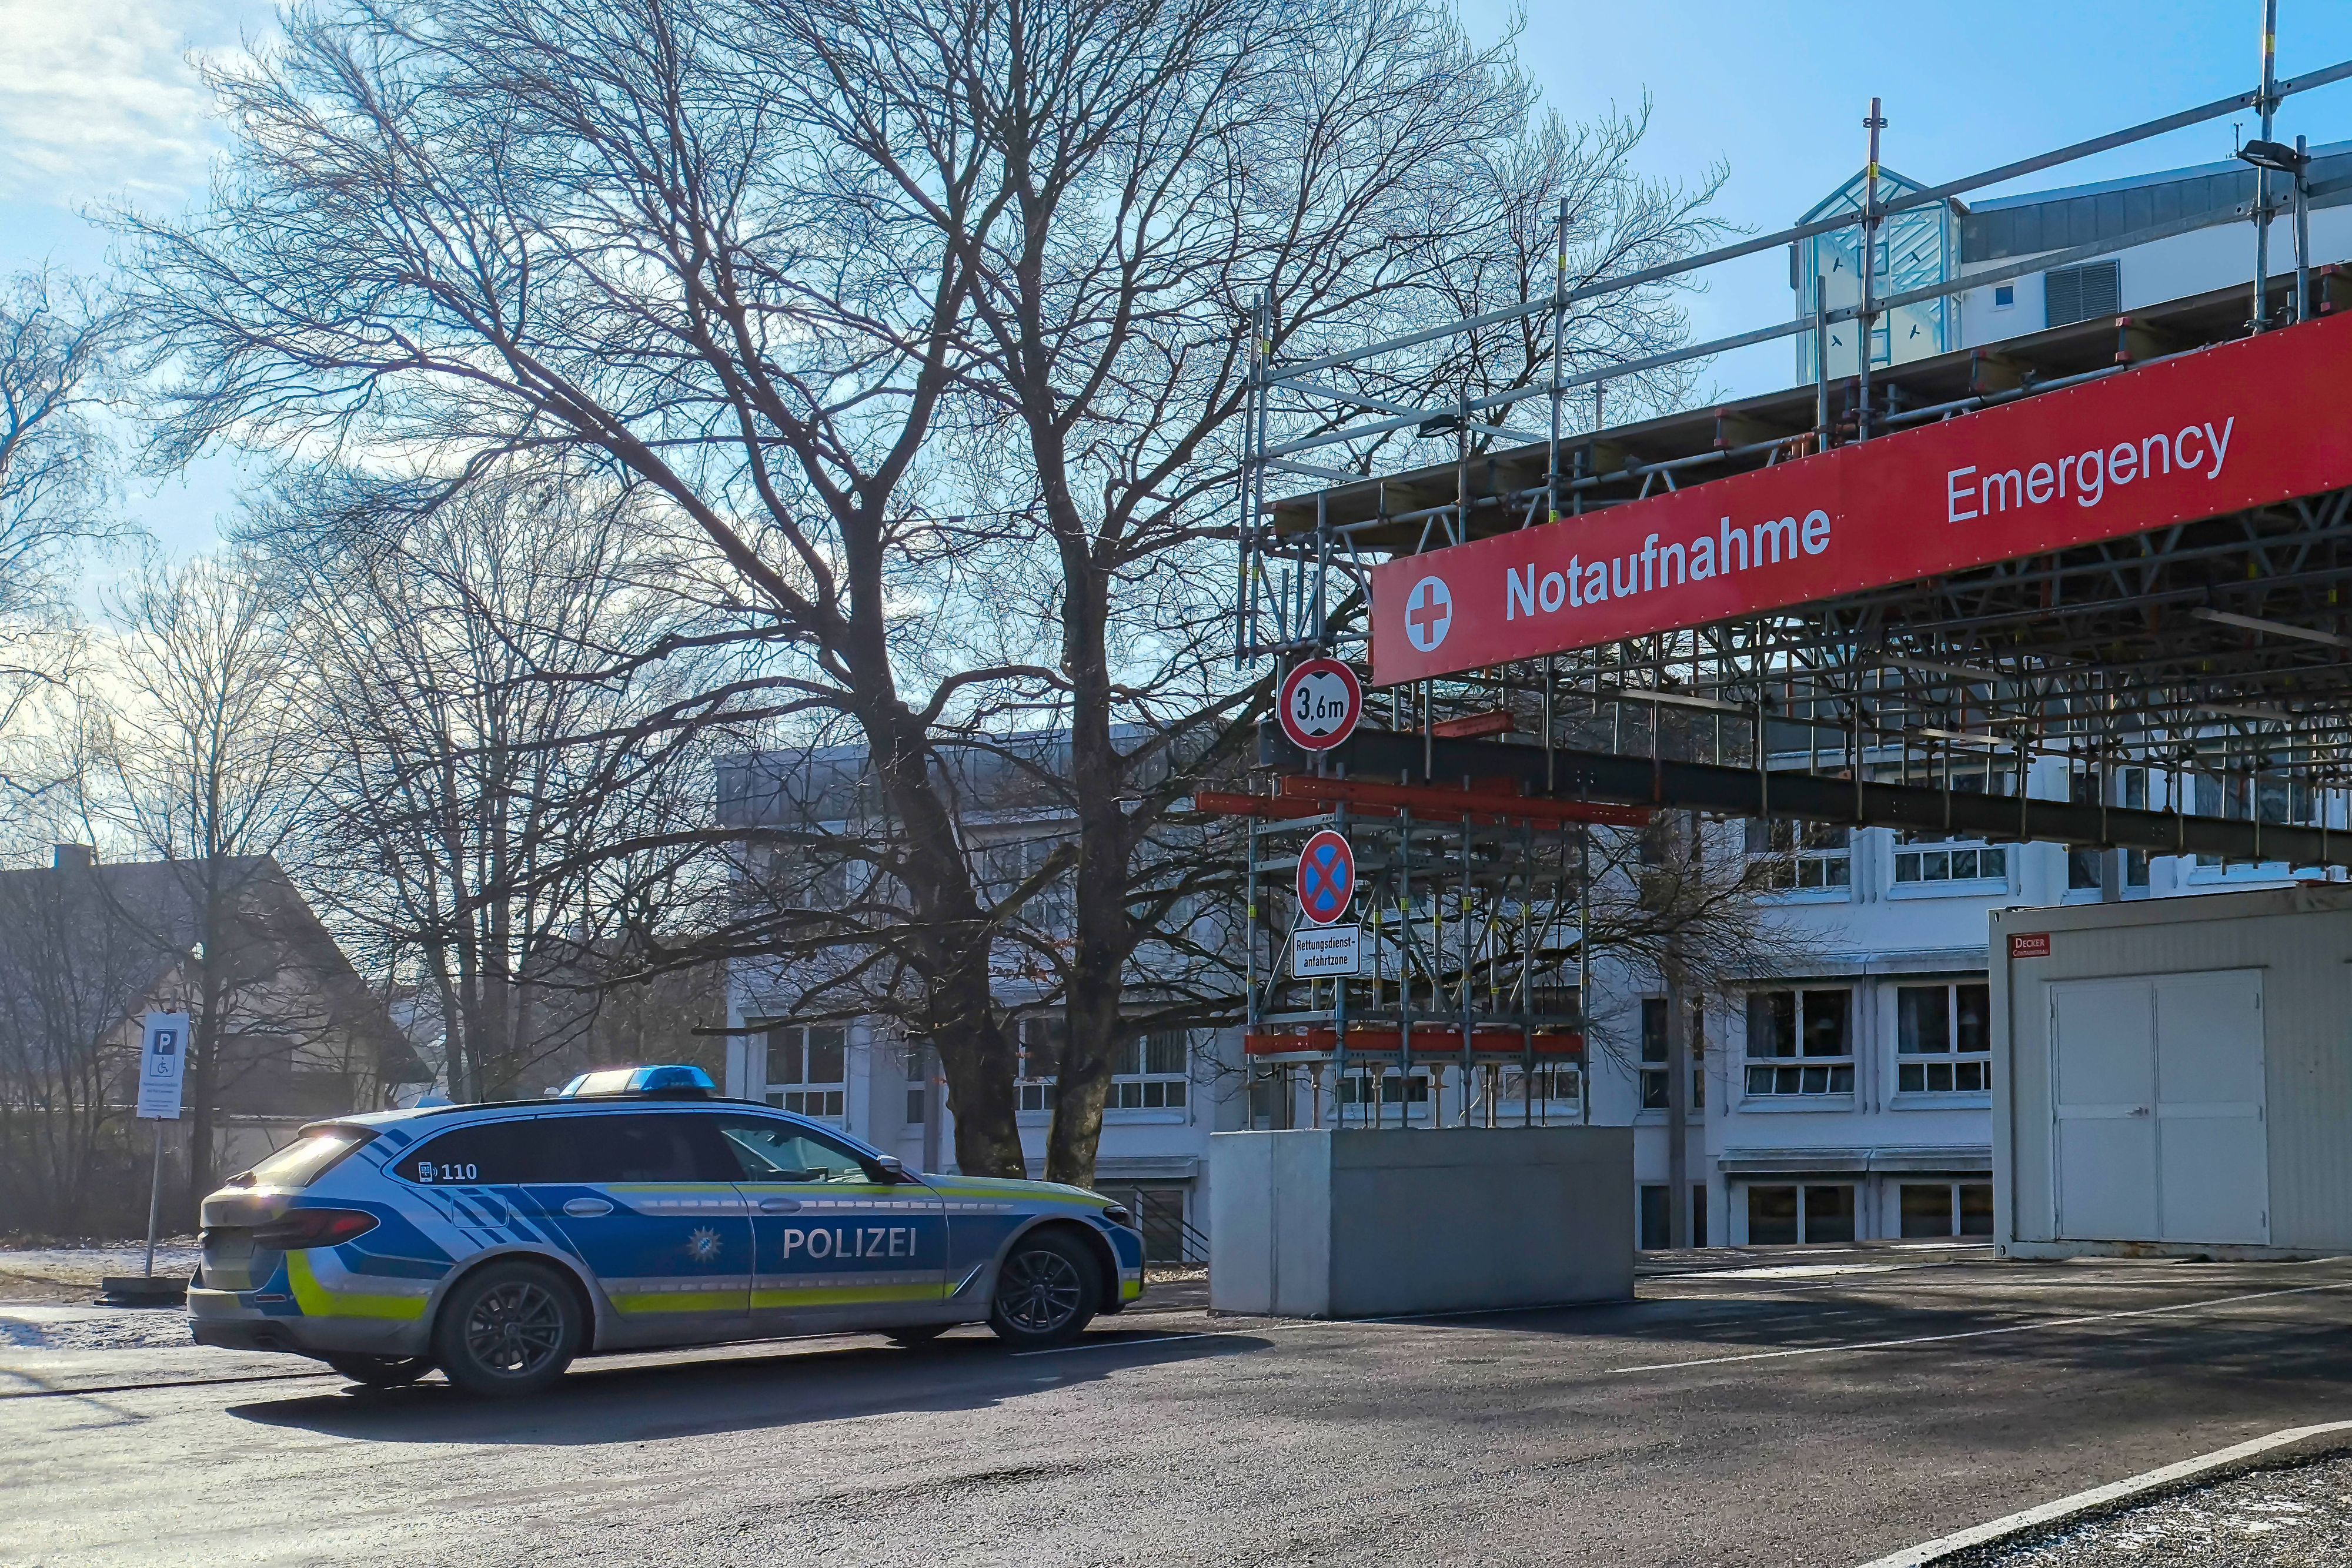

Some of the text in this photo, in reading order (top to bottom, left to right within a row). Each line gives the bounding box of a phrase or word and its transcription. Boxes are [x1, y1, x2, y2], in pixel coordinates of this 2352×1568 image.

[1506, 416, 2234, 621] Notaufnahme Emergency
[1297, 687, 1344, 721] 3,6m
[1297, 937, 1355, 952] Rettungsdienst-
[1304, 955, 1348, 968] anfahrtzone
[159, 1033, 171, 1053] P
[442, 1164, 477, 1179] 110
[783, 1228, 916, 1259] POLIZEI
